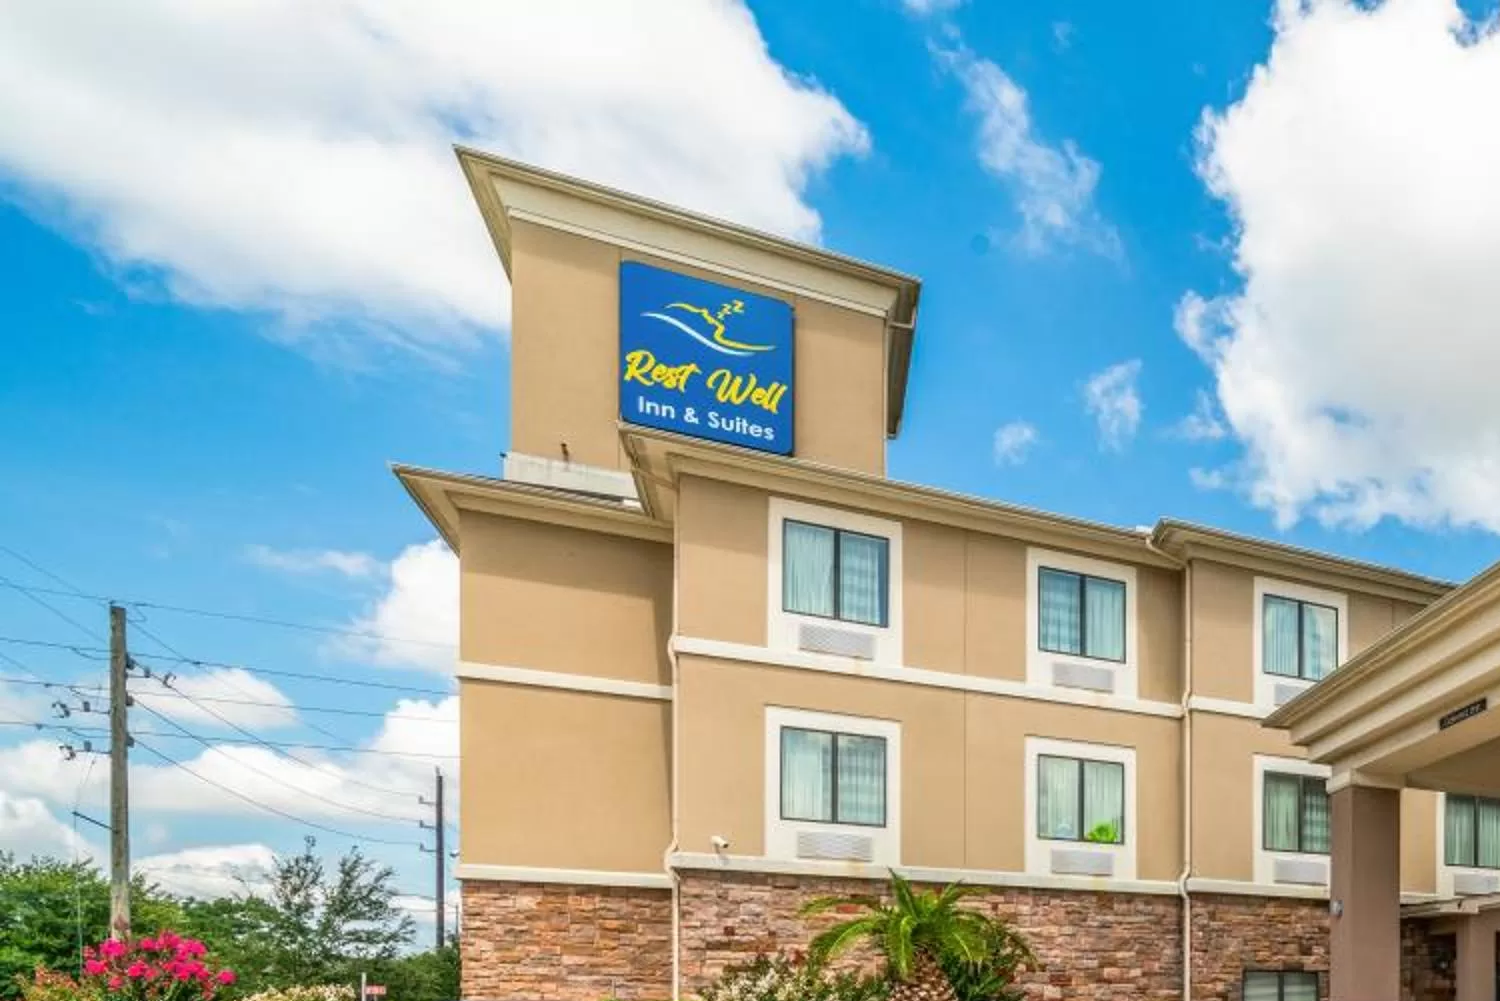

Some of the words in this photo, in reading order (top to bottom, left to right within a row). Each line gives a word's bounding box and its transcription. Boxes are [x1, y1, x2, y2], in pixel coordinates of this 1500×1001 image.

[623, 350, 702, 393] Rest
[706, 369, 788, 414] Well
[638, 395, 675, 419] Inn
[684, 407, 699, 424] &
[708, 411, 775, 440] Suites
